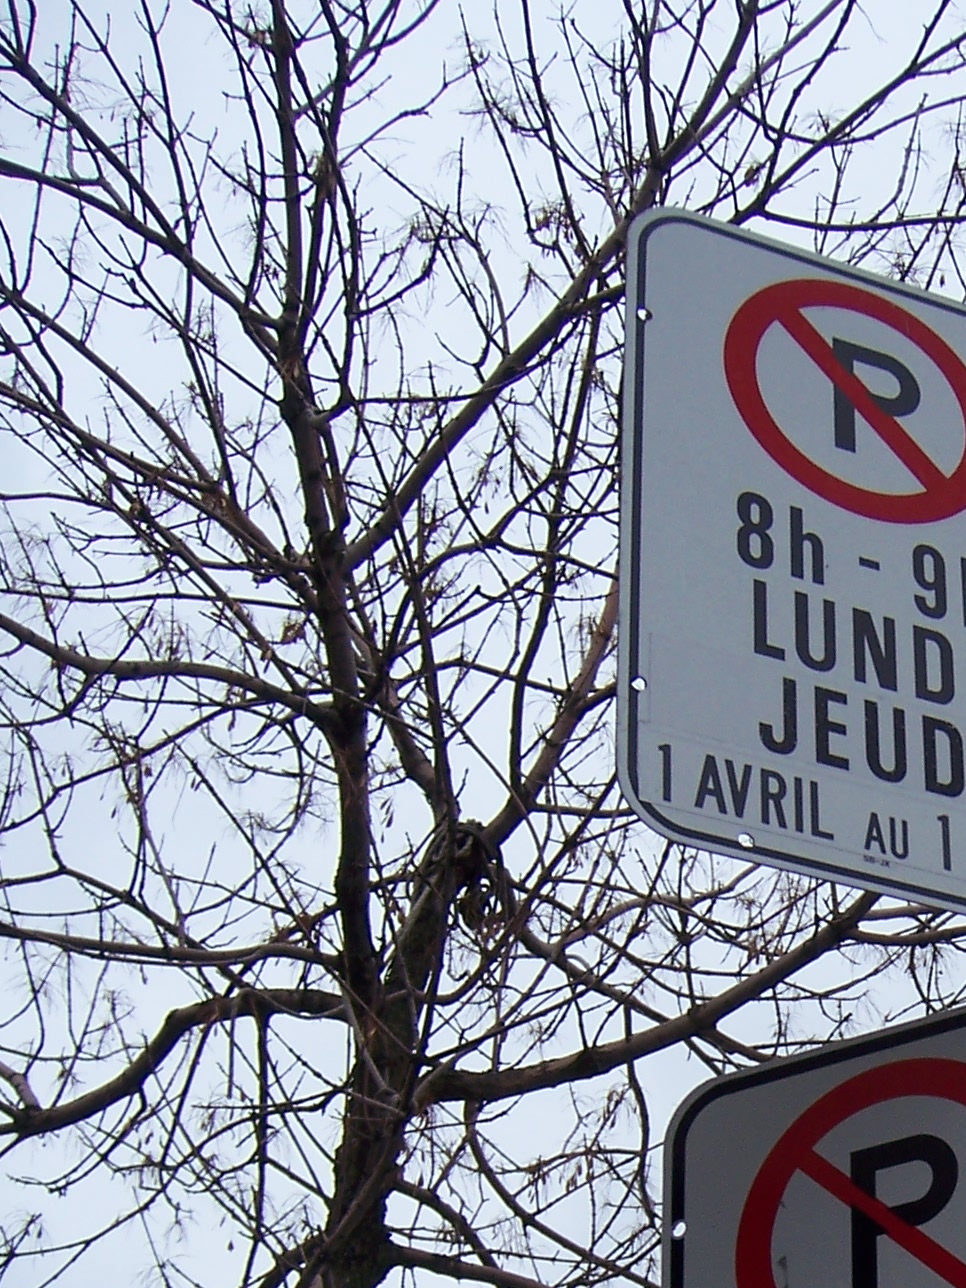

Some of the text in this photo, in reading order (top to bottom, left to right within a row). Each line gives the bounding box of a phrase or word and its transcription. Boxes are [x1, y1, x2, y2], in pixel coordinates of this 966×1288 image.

[736, 491, 825, 586] 8h
[656, 743, 673, 802] 1
[694, 755, 836, 841] AVRIL
[864, 811, 910, 860] AU
[937, 814, 954, 872] 1
